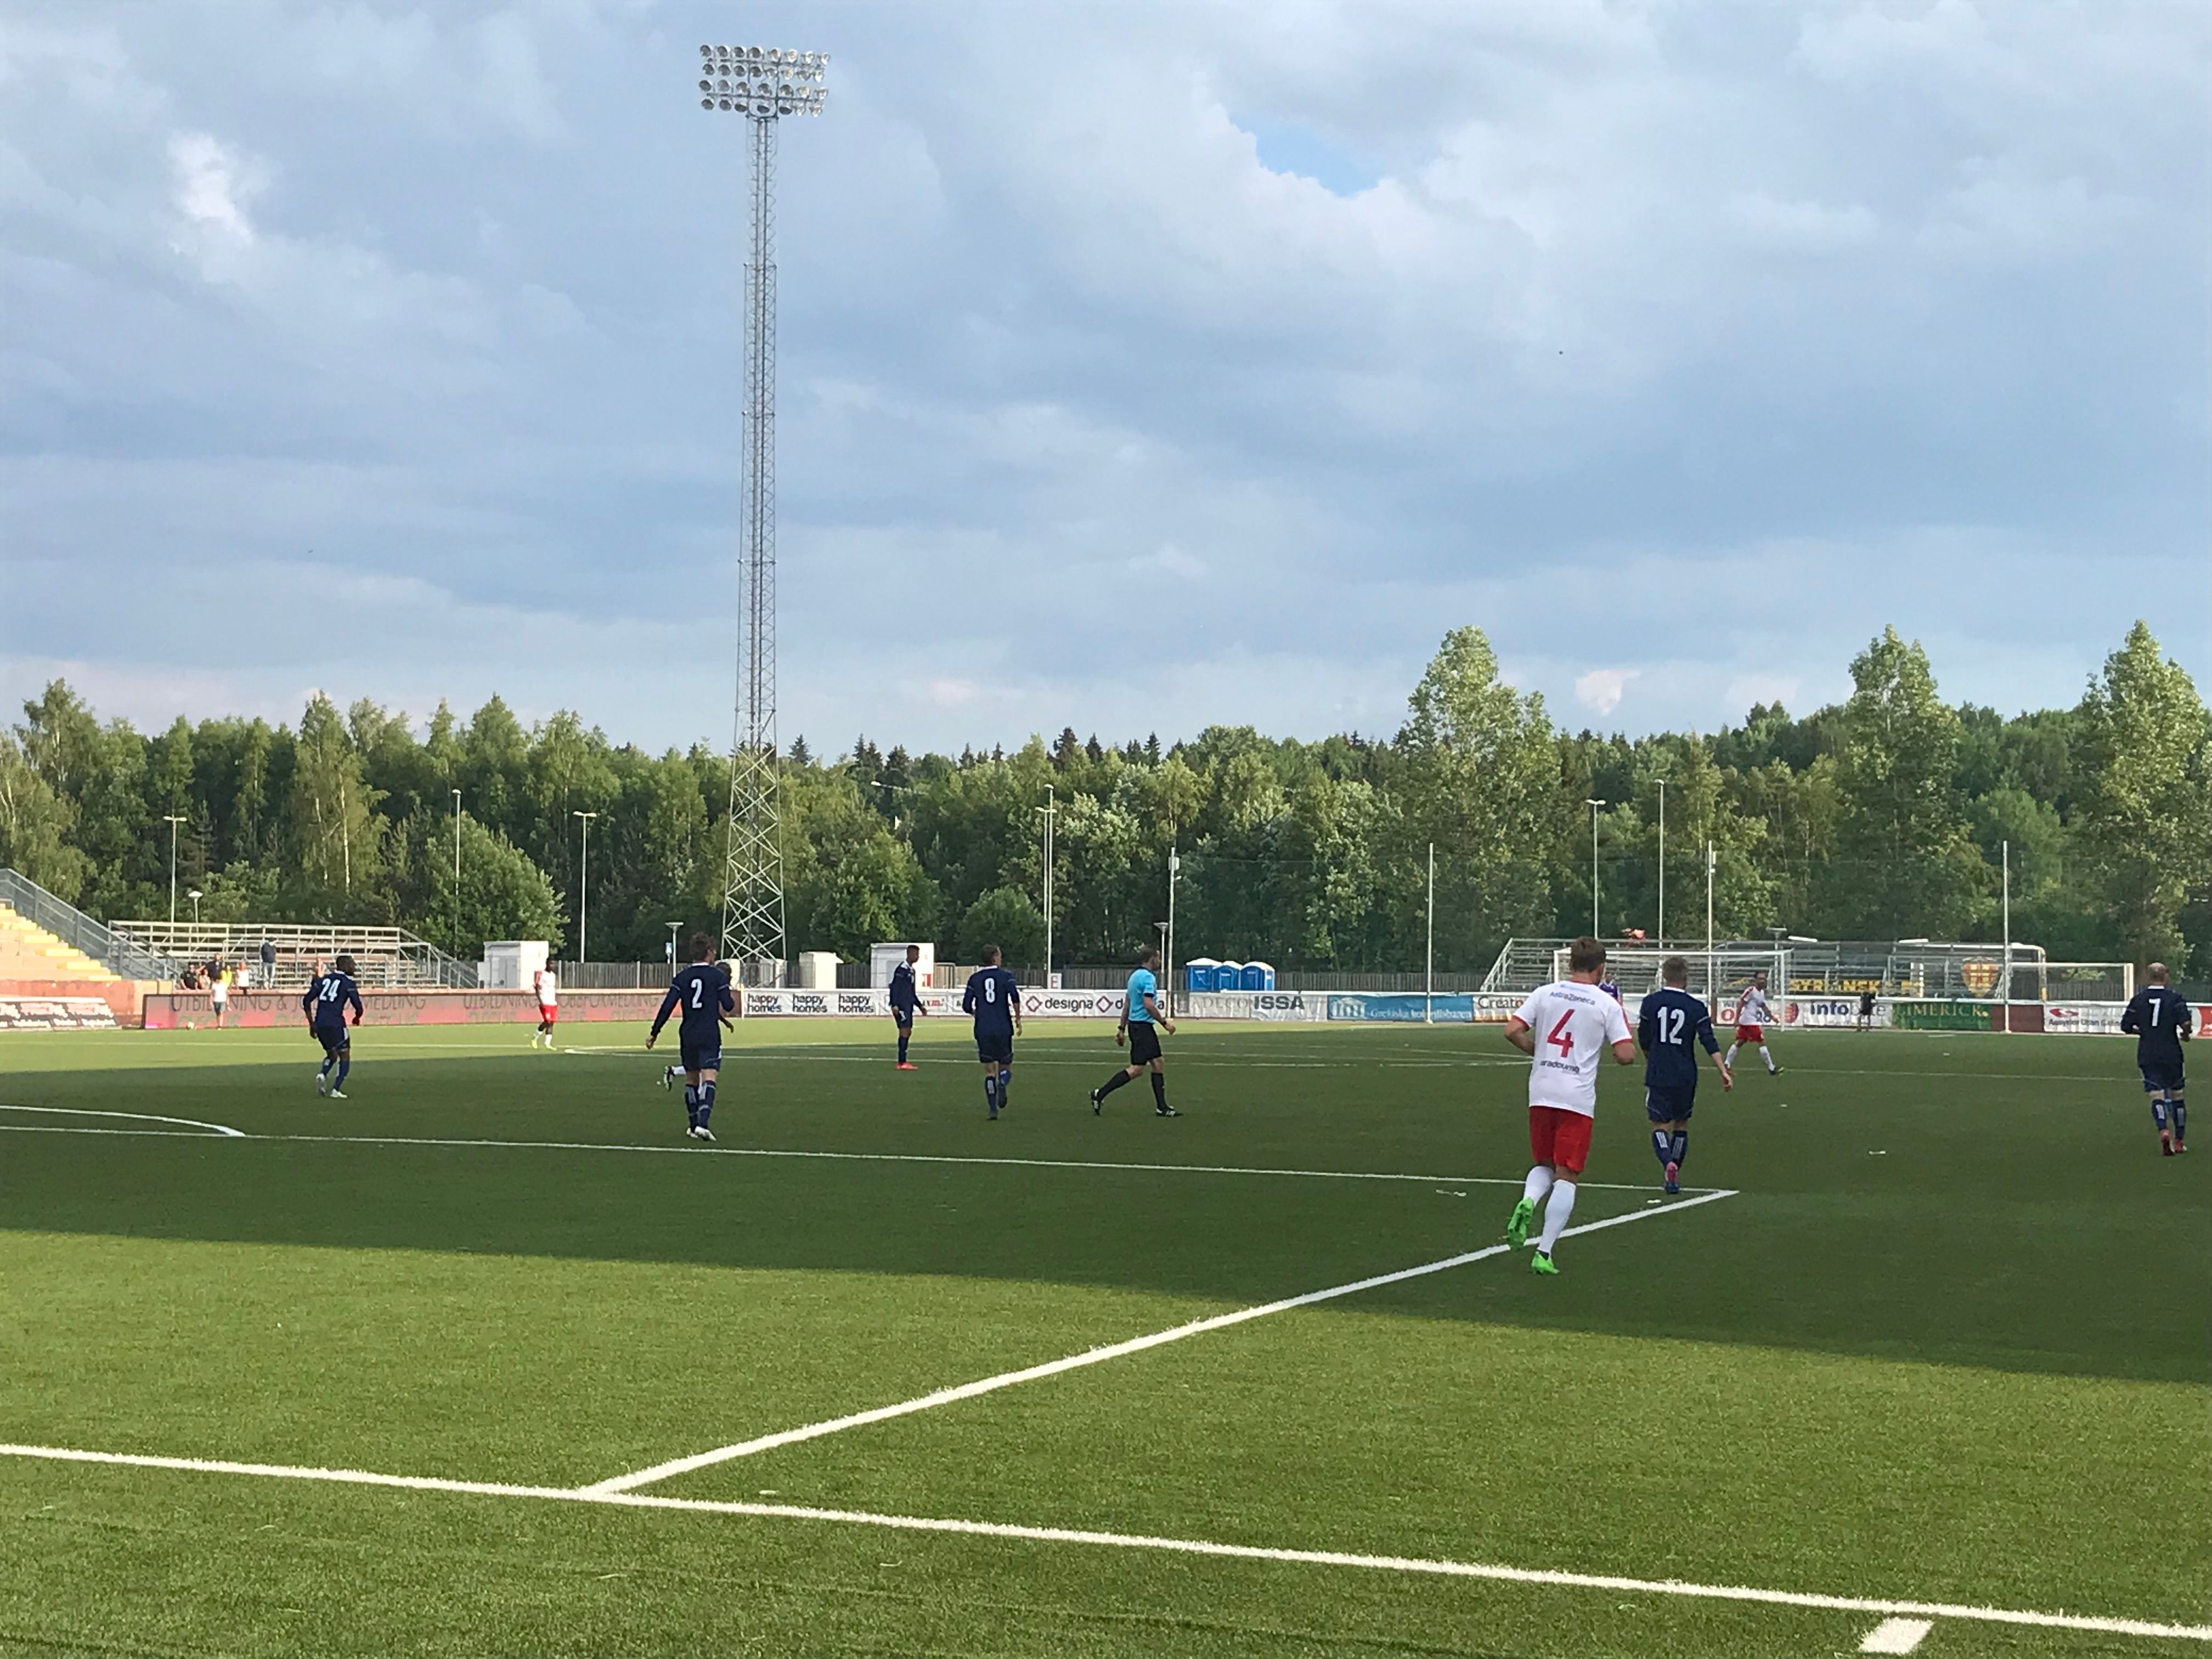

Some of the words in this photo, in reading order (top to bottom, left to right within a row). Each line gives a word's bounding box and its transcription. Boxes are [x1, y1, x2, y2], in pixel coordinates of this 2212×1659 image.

[319, 979, 341, 1002] 24
[691, 979, 703, 1008] 2
[985, 978, 995, 1003] 8
[172, 995, 272, 1012] UTBILNING
[748, 994, 779, 1004] happy
[793, 994, 825, 1005] happy
[839, 994, 871, 1005] happy
[1045, 997, 1093, 1012] designa
[1254, 996, 1305, 1009] ISSA
[1549, 991, 1595, 1006] AstraZeneca
[747, 1003, 782, 1013] homes
[793, 1003, 827, 1013] homes
[839, 1003, 874, 1013] homes
[2148, 998, 2161, 1026] 7
[1547, 1008, 1575, 1058] 4
[1657, 1006, 1685, 1045] 12
